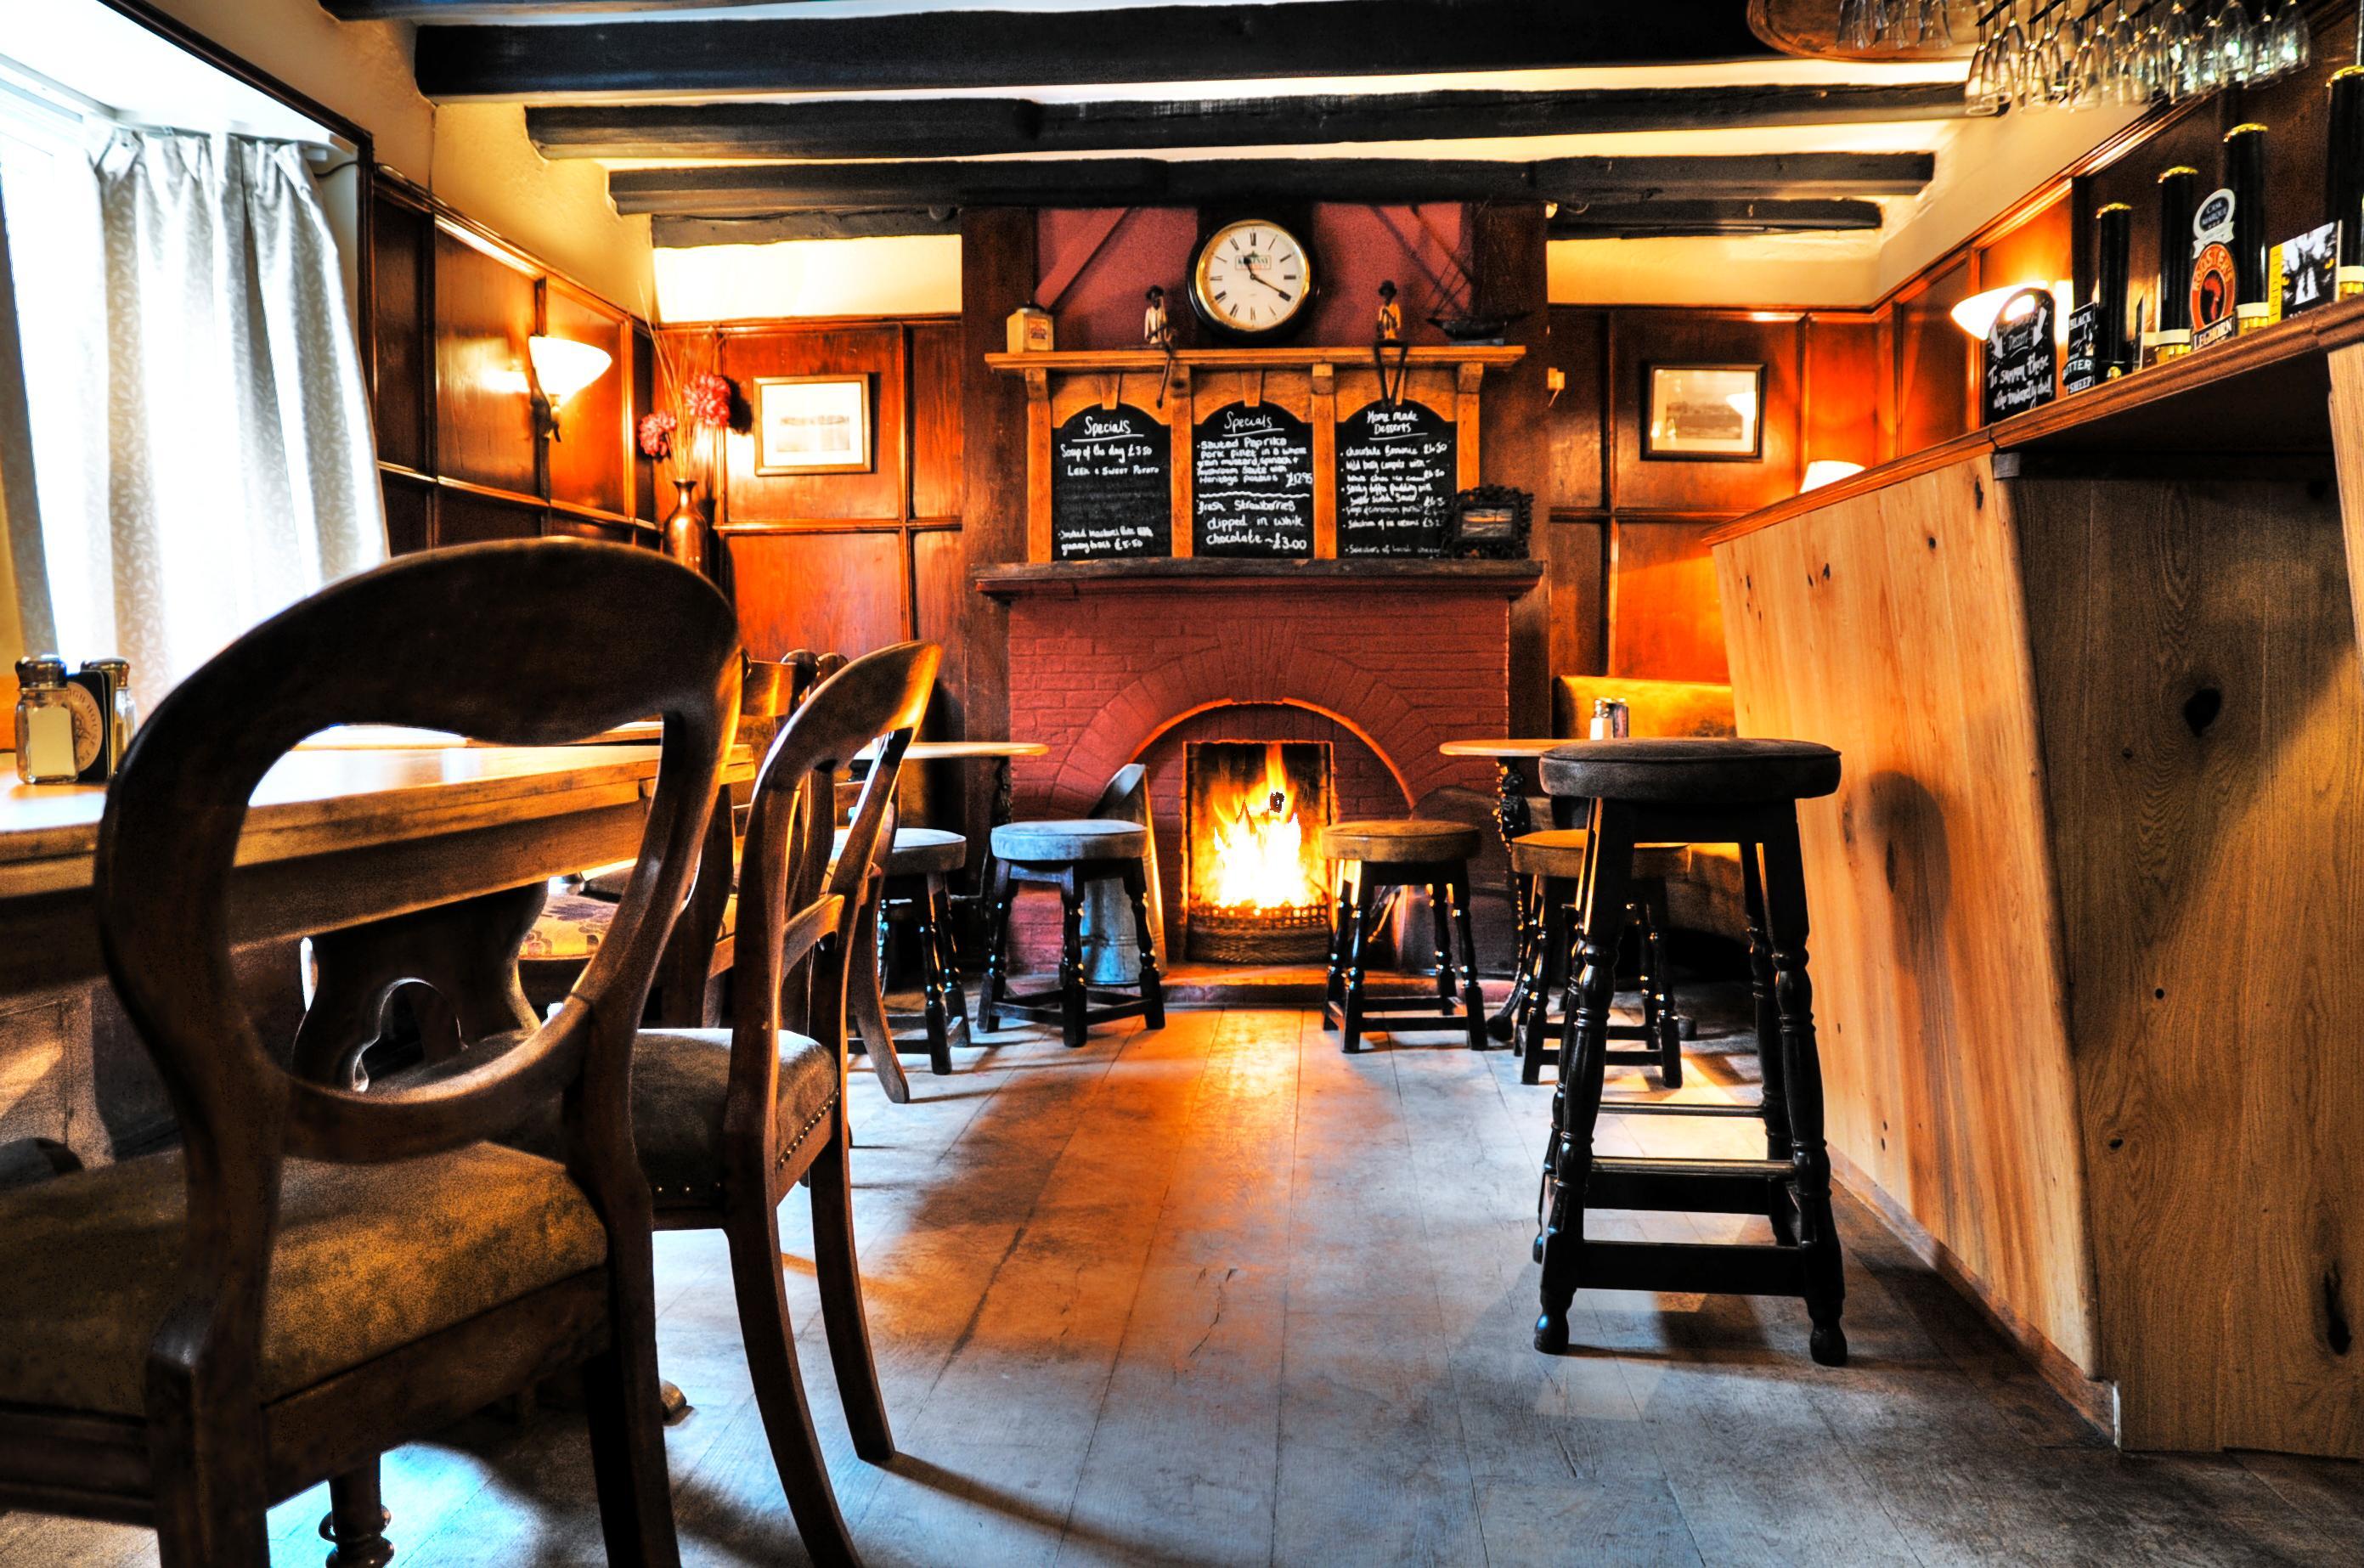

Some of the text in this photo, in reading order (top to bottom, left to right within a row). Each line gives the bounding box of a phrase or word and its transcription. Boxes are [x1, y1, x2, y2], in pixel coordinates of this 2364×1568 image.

[2069, 310, 2092, 330] BLACK
[2062, 358, 2092, 379] BITTER
[2069, 375, 2092, 394] SHEEP
[1084, 415, 1131, 437] Specials
[1224, 411, 1272, 433] Specials
[1367, 410, 1390, 424] Home
[1374, 422, 1411, 436] Desserts
[1092, 443, 1105, 456] the
[1108, 443, 1126, 463] day
[1206, 514, 1305, 533] dipped in white
[1205, 528, 1263, 545] chocolate
